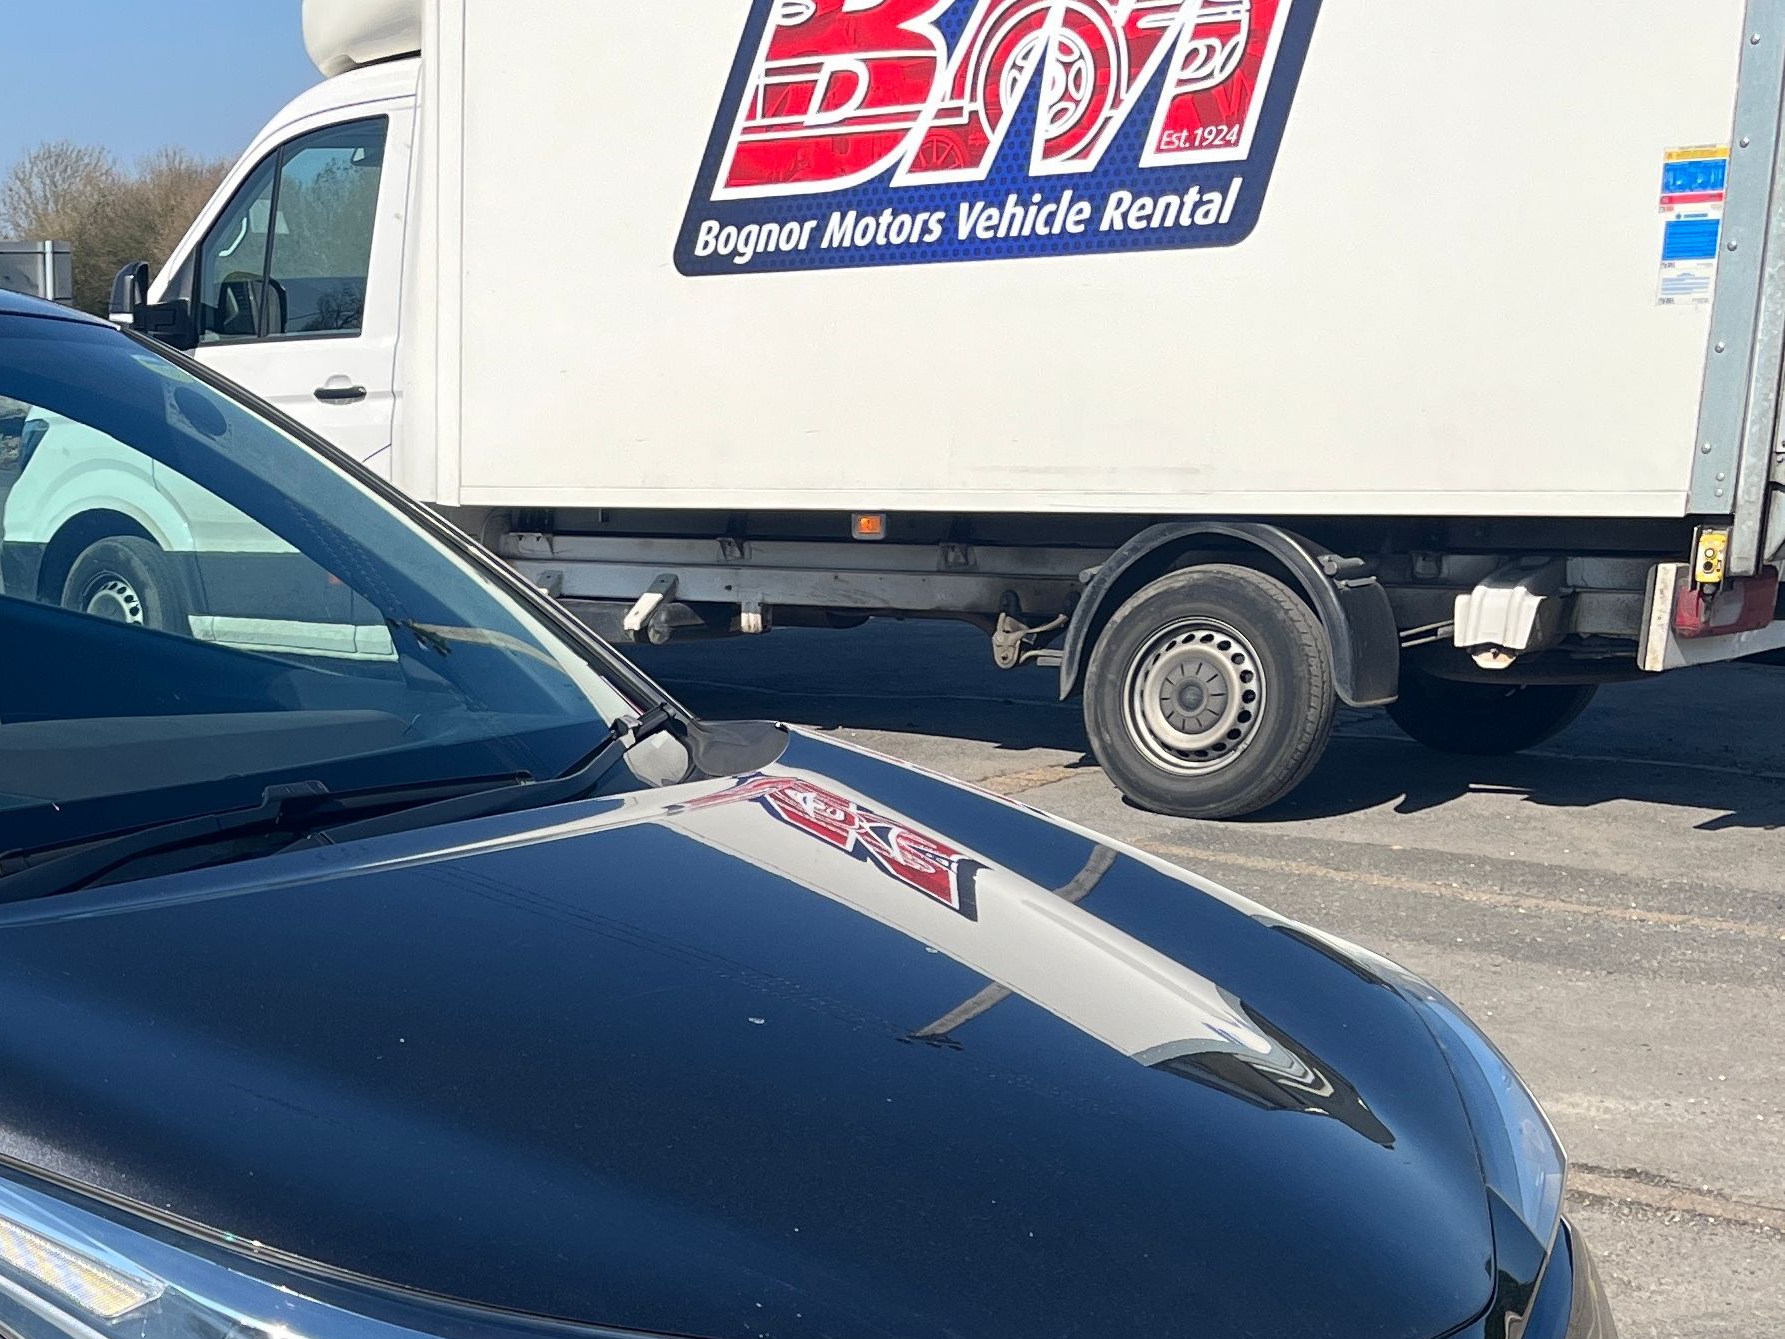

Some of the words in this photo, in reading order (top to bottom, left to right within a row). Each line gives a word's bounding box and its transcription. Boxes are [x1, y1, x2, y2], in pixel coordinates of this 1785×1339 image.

[694, 216, 817, 264] Bognor
[820, 208, 943, 249] Motors
[956, 189, 1089, 241] Vehicle
[1099, 177, 1244, 231] Rental
